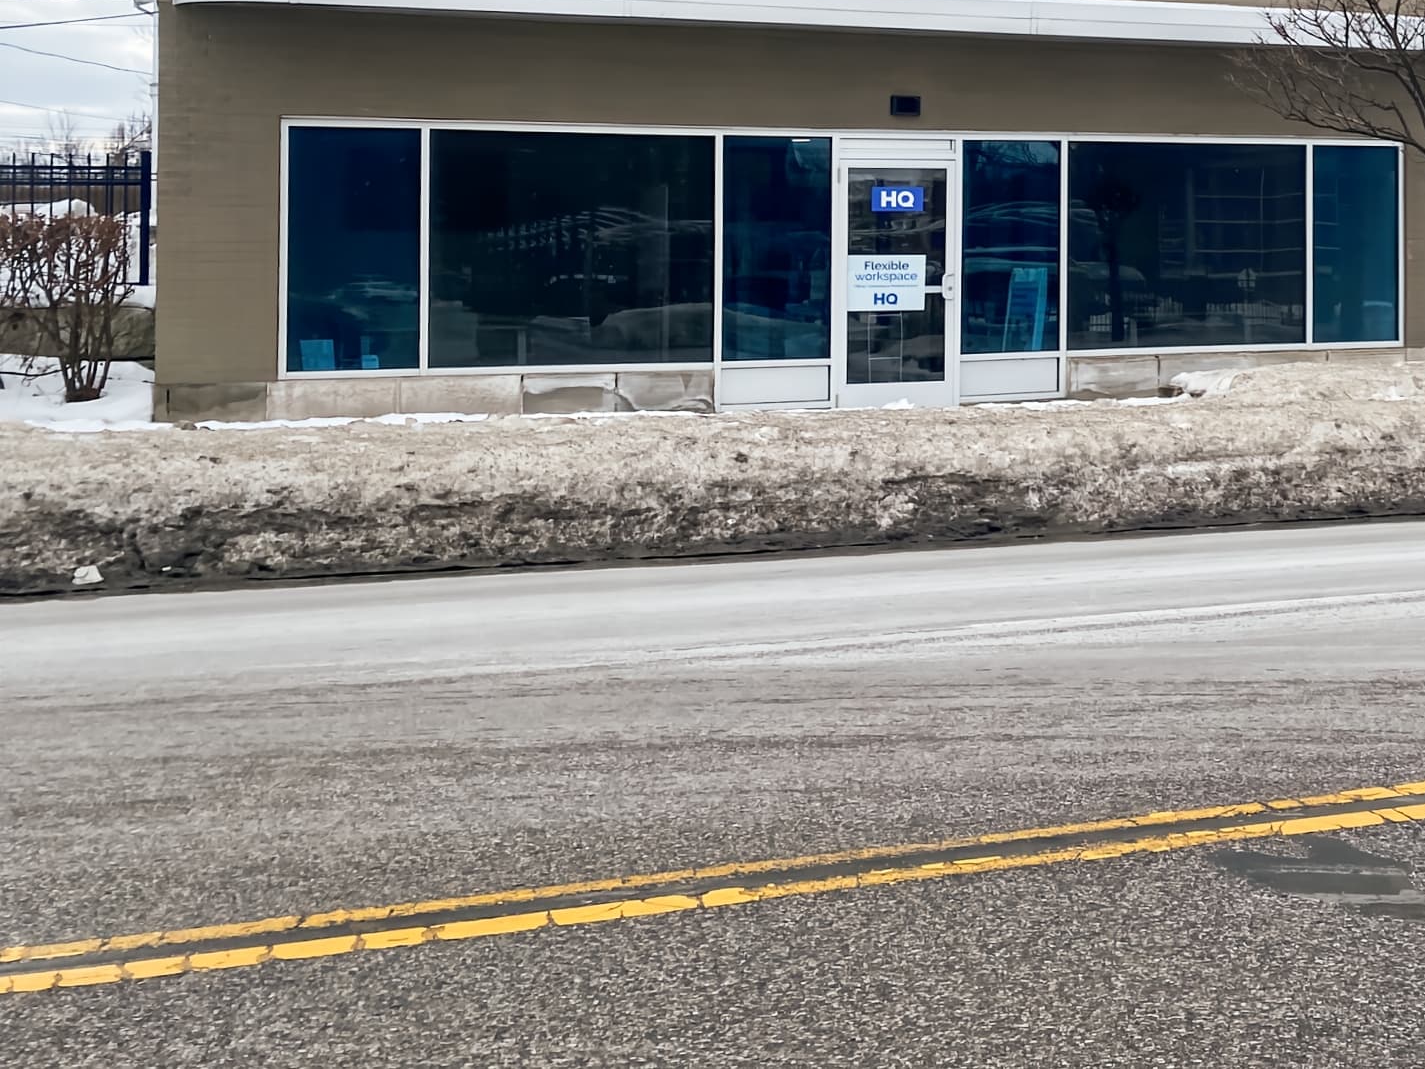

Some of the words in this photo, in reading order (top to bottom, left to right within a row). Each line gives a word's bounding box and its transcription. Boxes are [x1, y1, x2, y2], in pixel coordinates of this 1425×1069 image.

[880, 190, 915, 208] HQ
[864, 260, 910, 271] Flexible
[855, 271, 918, 283] workspace
[873, 292, 899, 306] HQ
